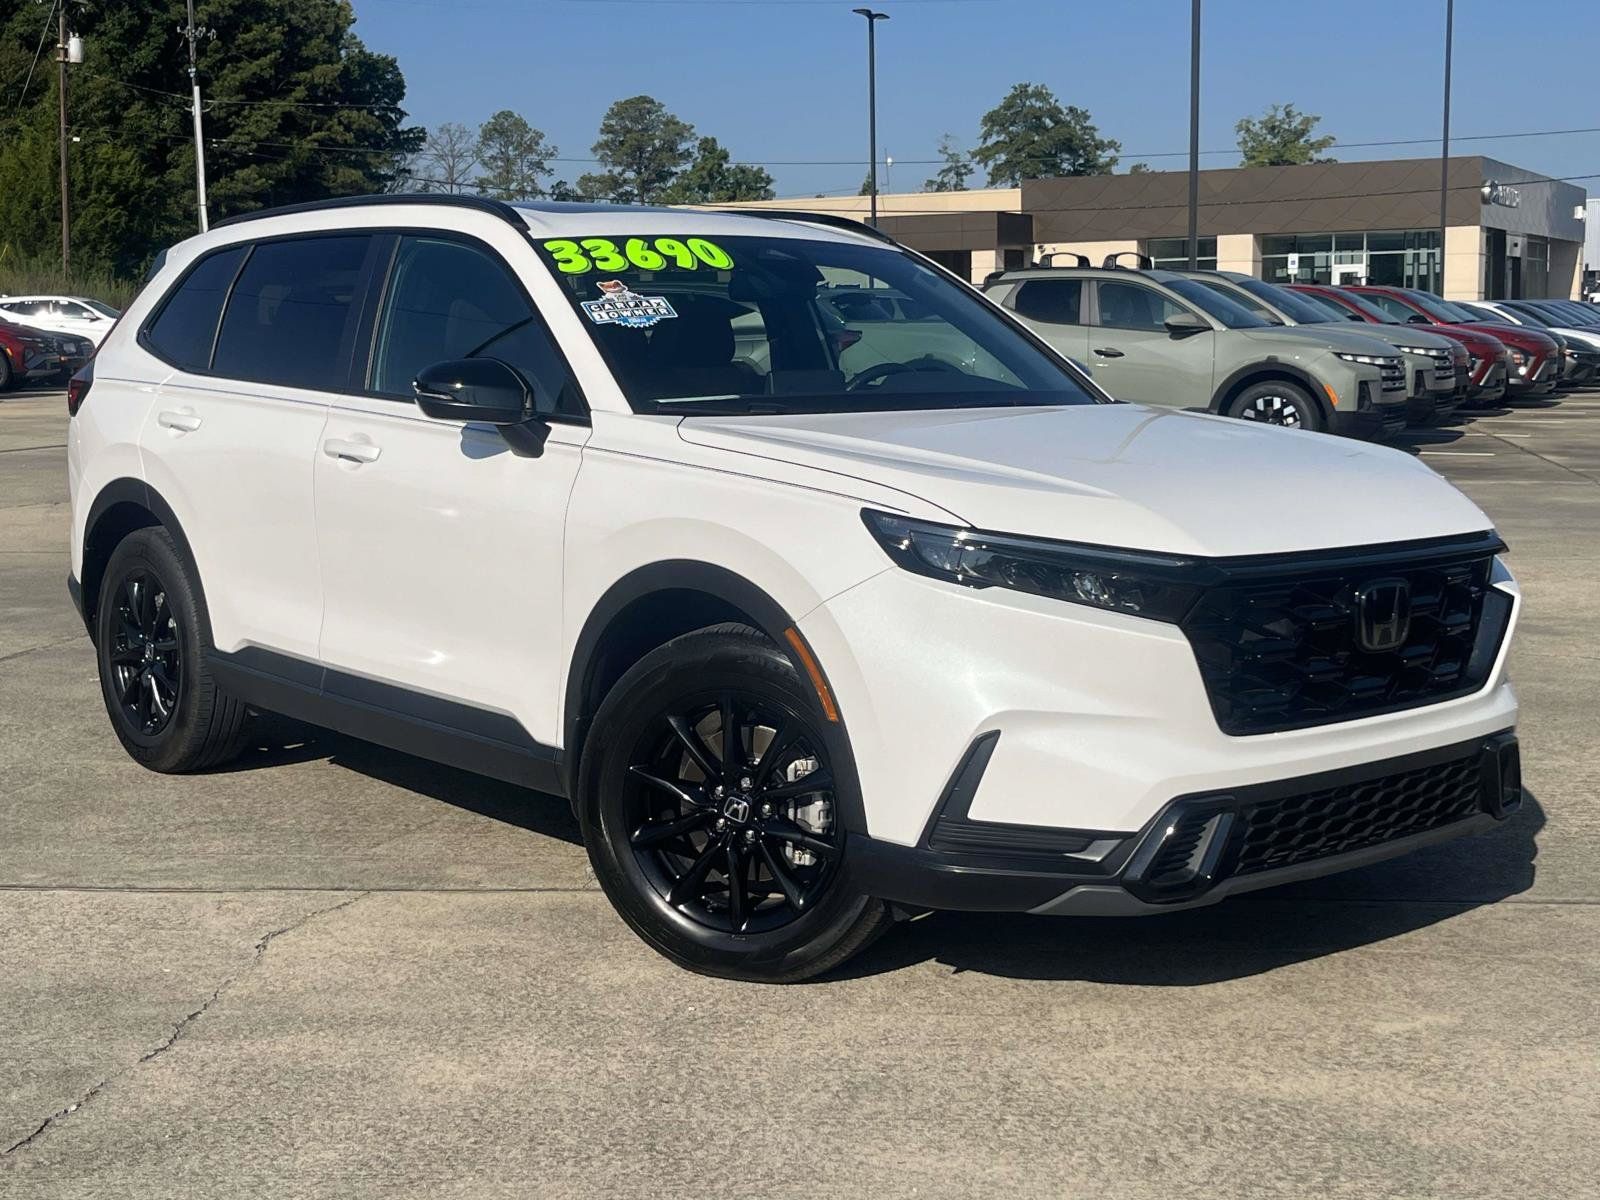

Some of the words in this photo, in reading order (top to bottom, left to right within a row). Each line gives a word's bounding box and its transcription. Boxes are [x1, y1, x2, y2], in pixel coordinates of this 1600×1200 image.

[543, 238, 734, 274] 33690
[589, 299, 665, 311] CARFAX
[608, 308, 669, 319] OWNER
